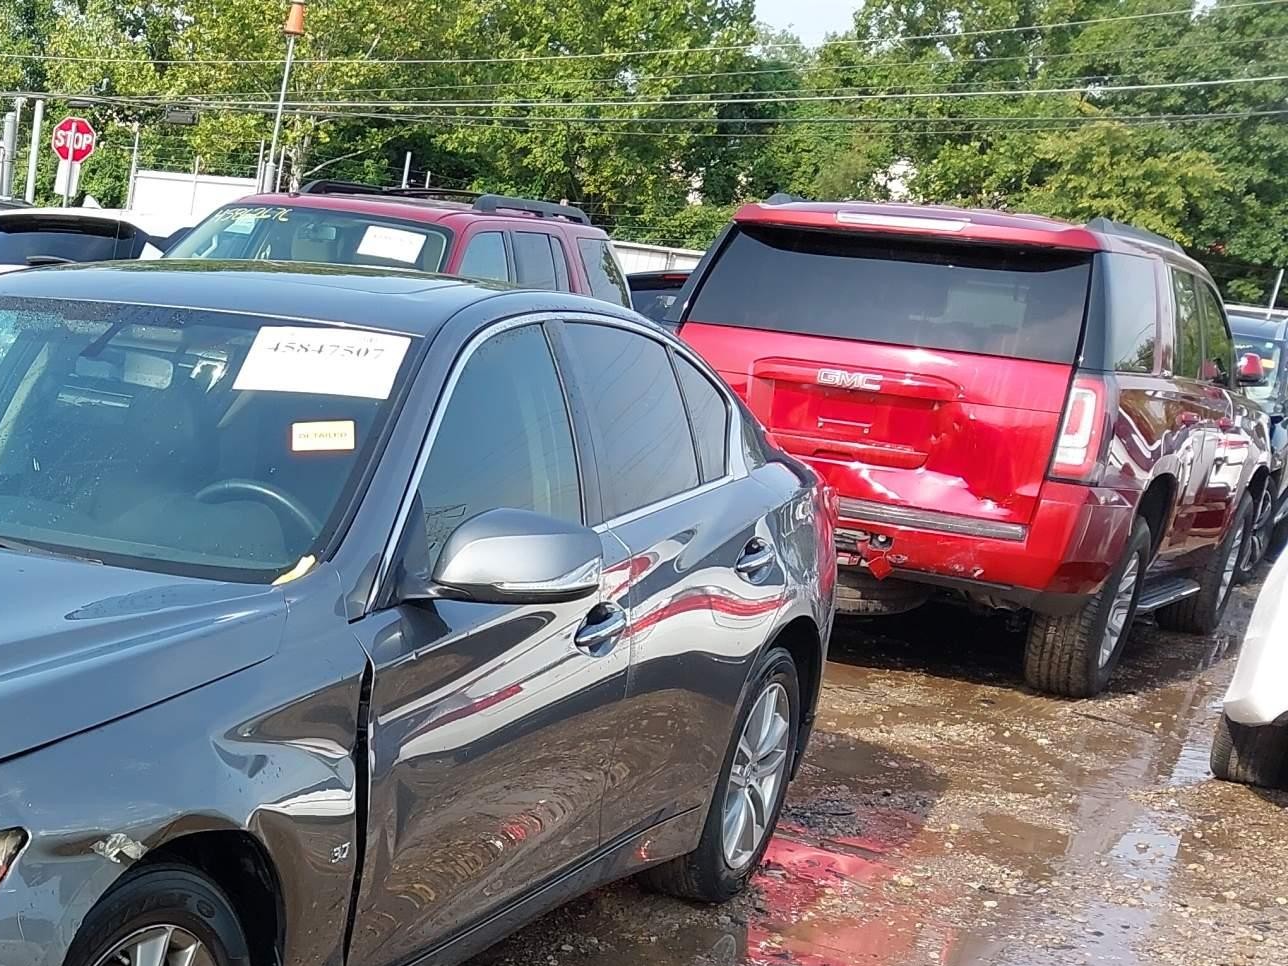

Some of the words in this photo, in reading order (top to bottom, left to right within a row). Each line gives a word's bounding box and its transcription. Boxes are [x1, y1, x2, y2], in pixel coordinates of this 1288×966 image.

[55, 130, 92, 150] STOP
[265, 341, 385, 359] 45847507
[817, 368, 883, 391] GMC
